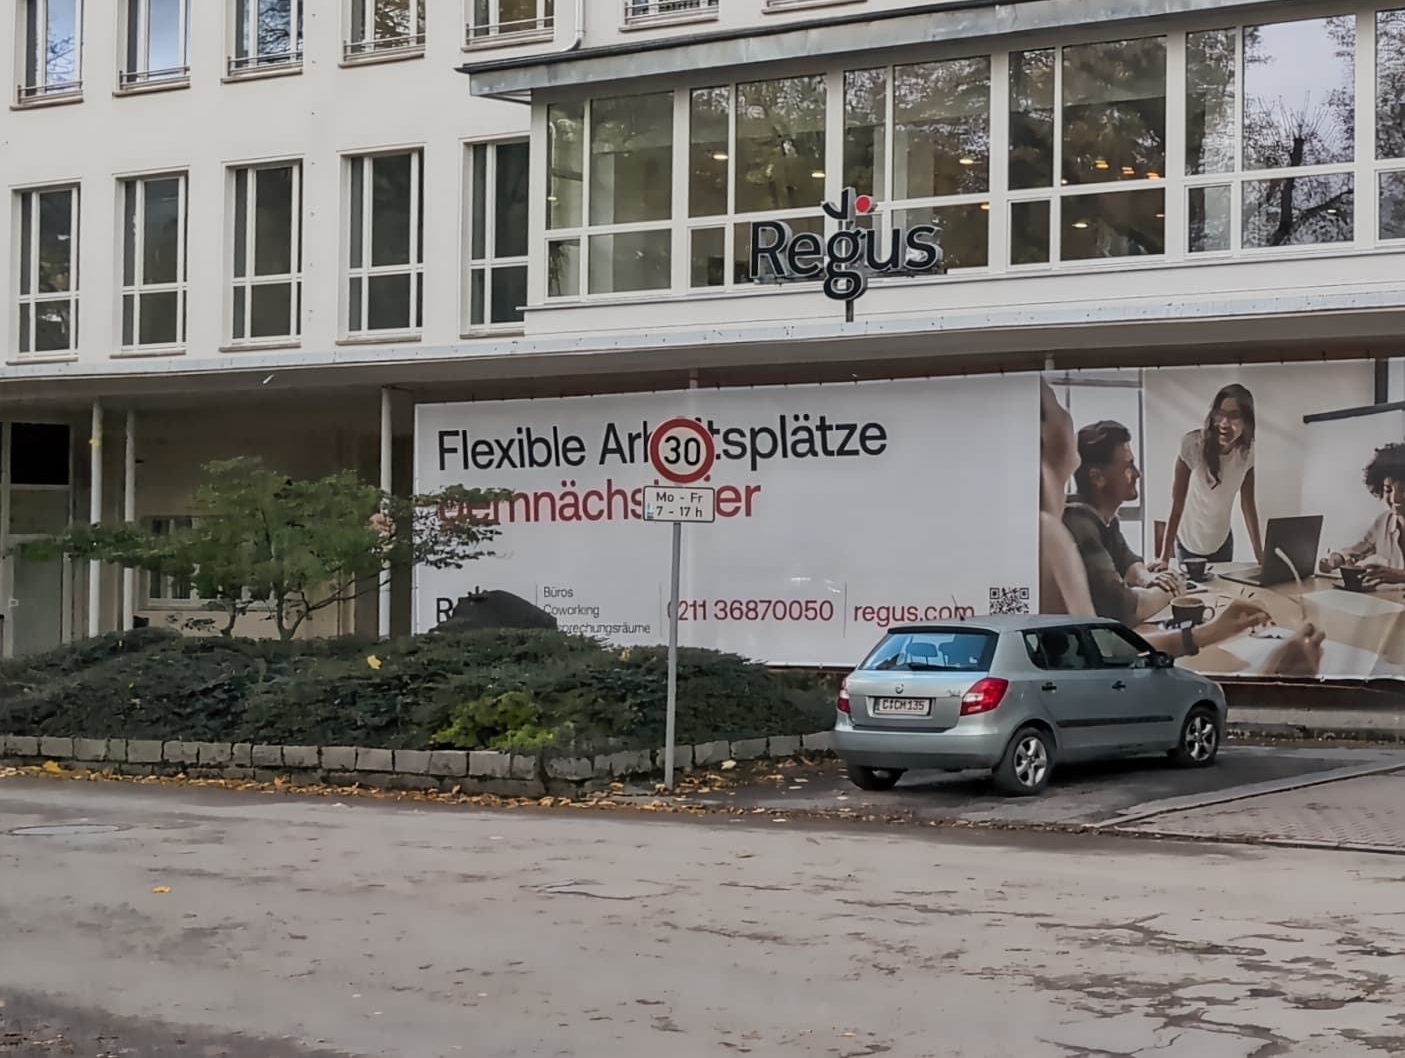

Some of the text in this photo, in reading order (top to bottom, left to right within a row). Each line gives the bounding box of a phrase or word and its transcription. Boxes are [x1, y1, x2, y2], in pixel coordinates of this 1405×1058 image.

[750, 220, 943, 300] Regus
[438, 414, 888, 471] Flexible Arsplätze
[664, 435, 701, 466] 30
[438, 479, 659, 524] emnächs
[656, 491, 674, 502] Mo
[691, 492, 704, 502] Fr
[656, 506, 663, 516] 7
[680, 506, 691, 517] 17
[695, 506, 703, 518] h
[543, 585, 574, 598] Büros
[543, 603, 600, 618] Coworking
[713, 599, 834, 622] 36870050
[854, 605, 975, 628] regus.com
